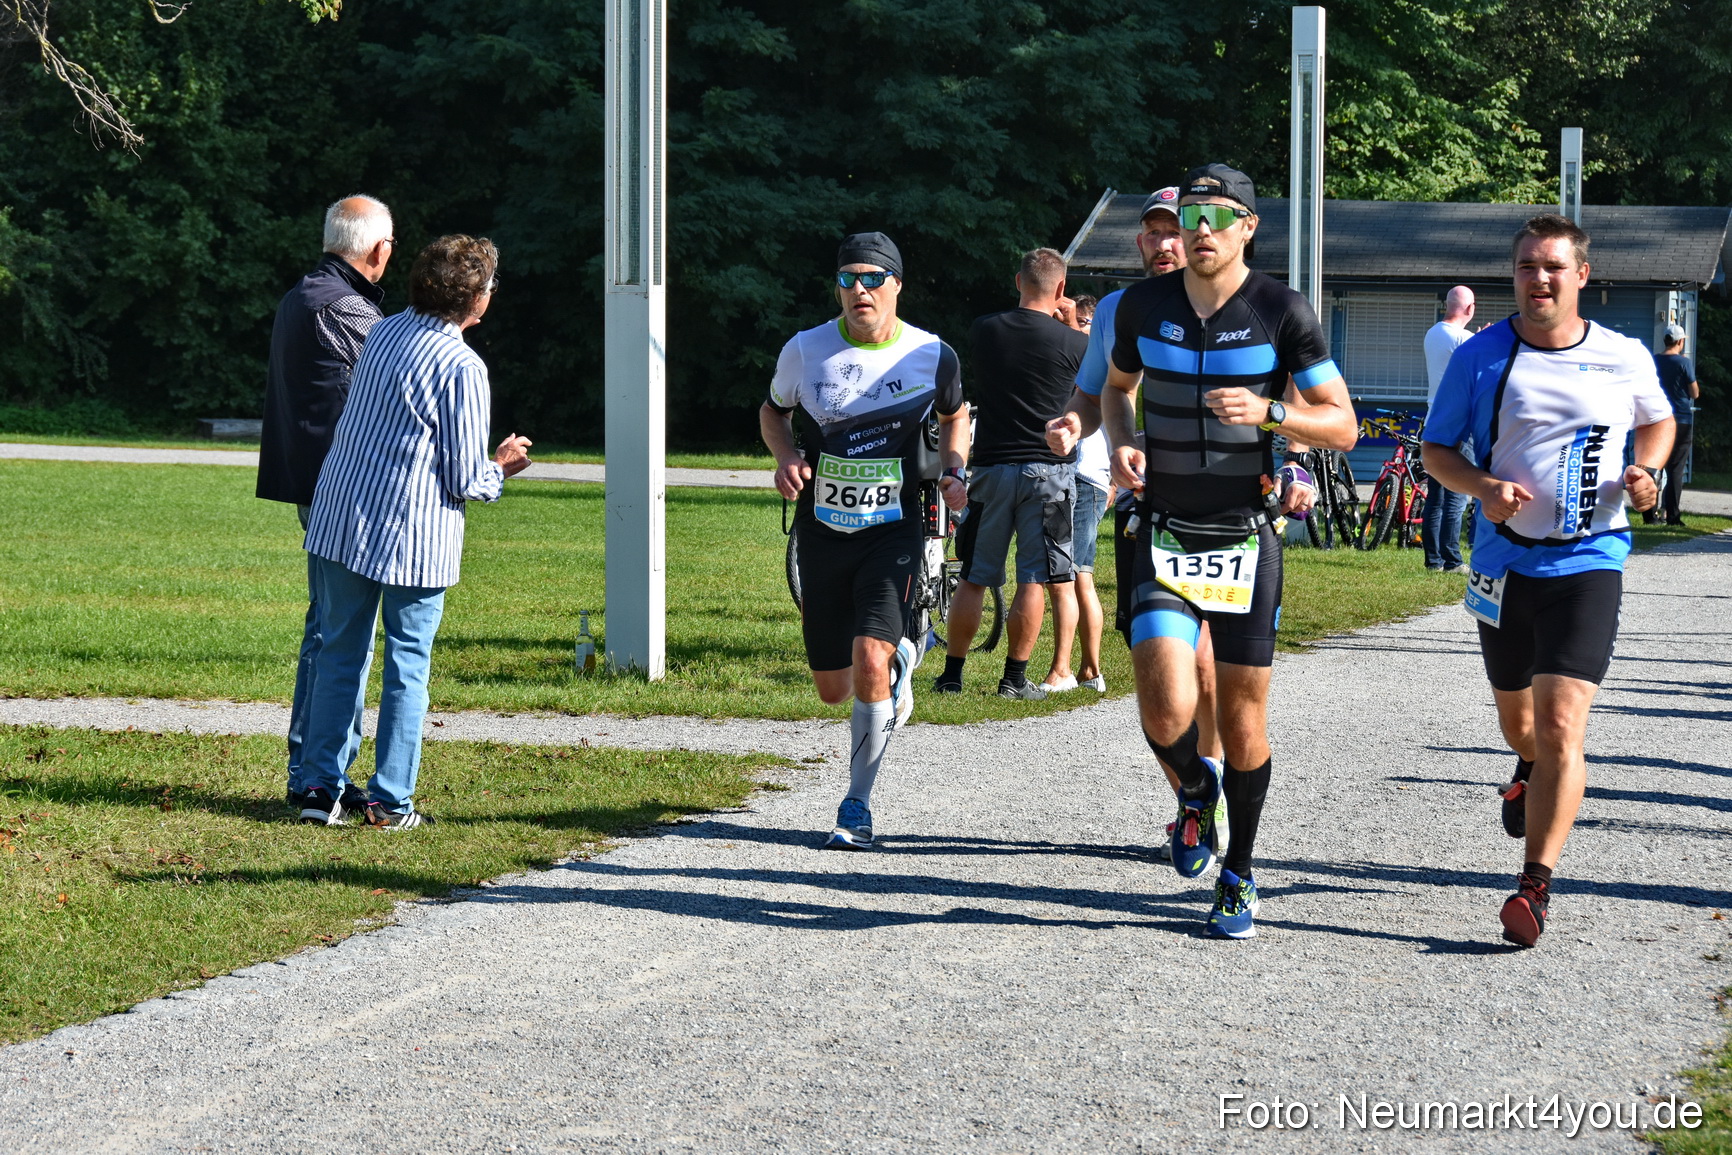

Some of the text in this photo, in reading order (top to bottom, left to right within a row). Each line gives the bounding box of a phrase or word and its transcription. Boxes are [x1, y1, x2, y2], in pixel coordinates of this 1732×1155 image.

[886, 379, 903, 394] TV
[849, 424, 891, 442] HT GROUP
[847, 437, 887, 456] RANDOW
[824, 459, 894, 478] BOCK
[825, 483, 891, 508] 2648
[1553, 445, 1568, 530] WASTE WATER Solutions
[830, 512, 885, 526] GÜNTER
[1166, 554, 1242, 580] 1351
